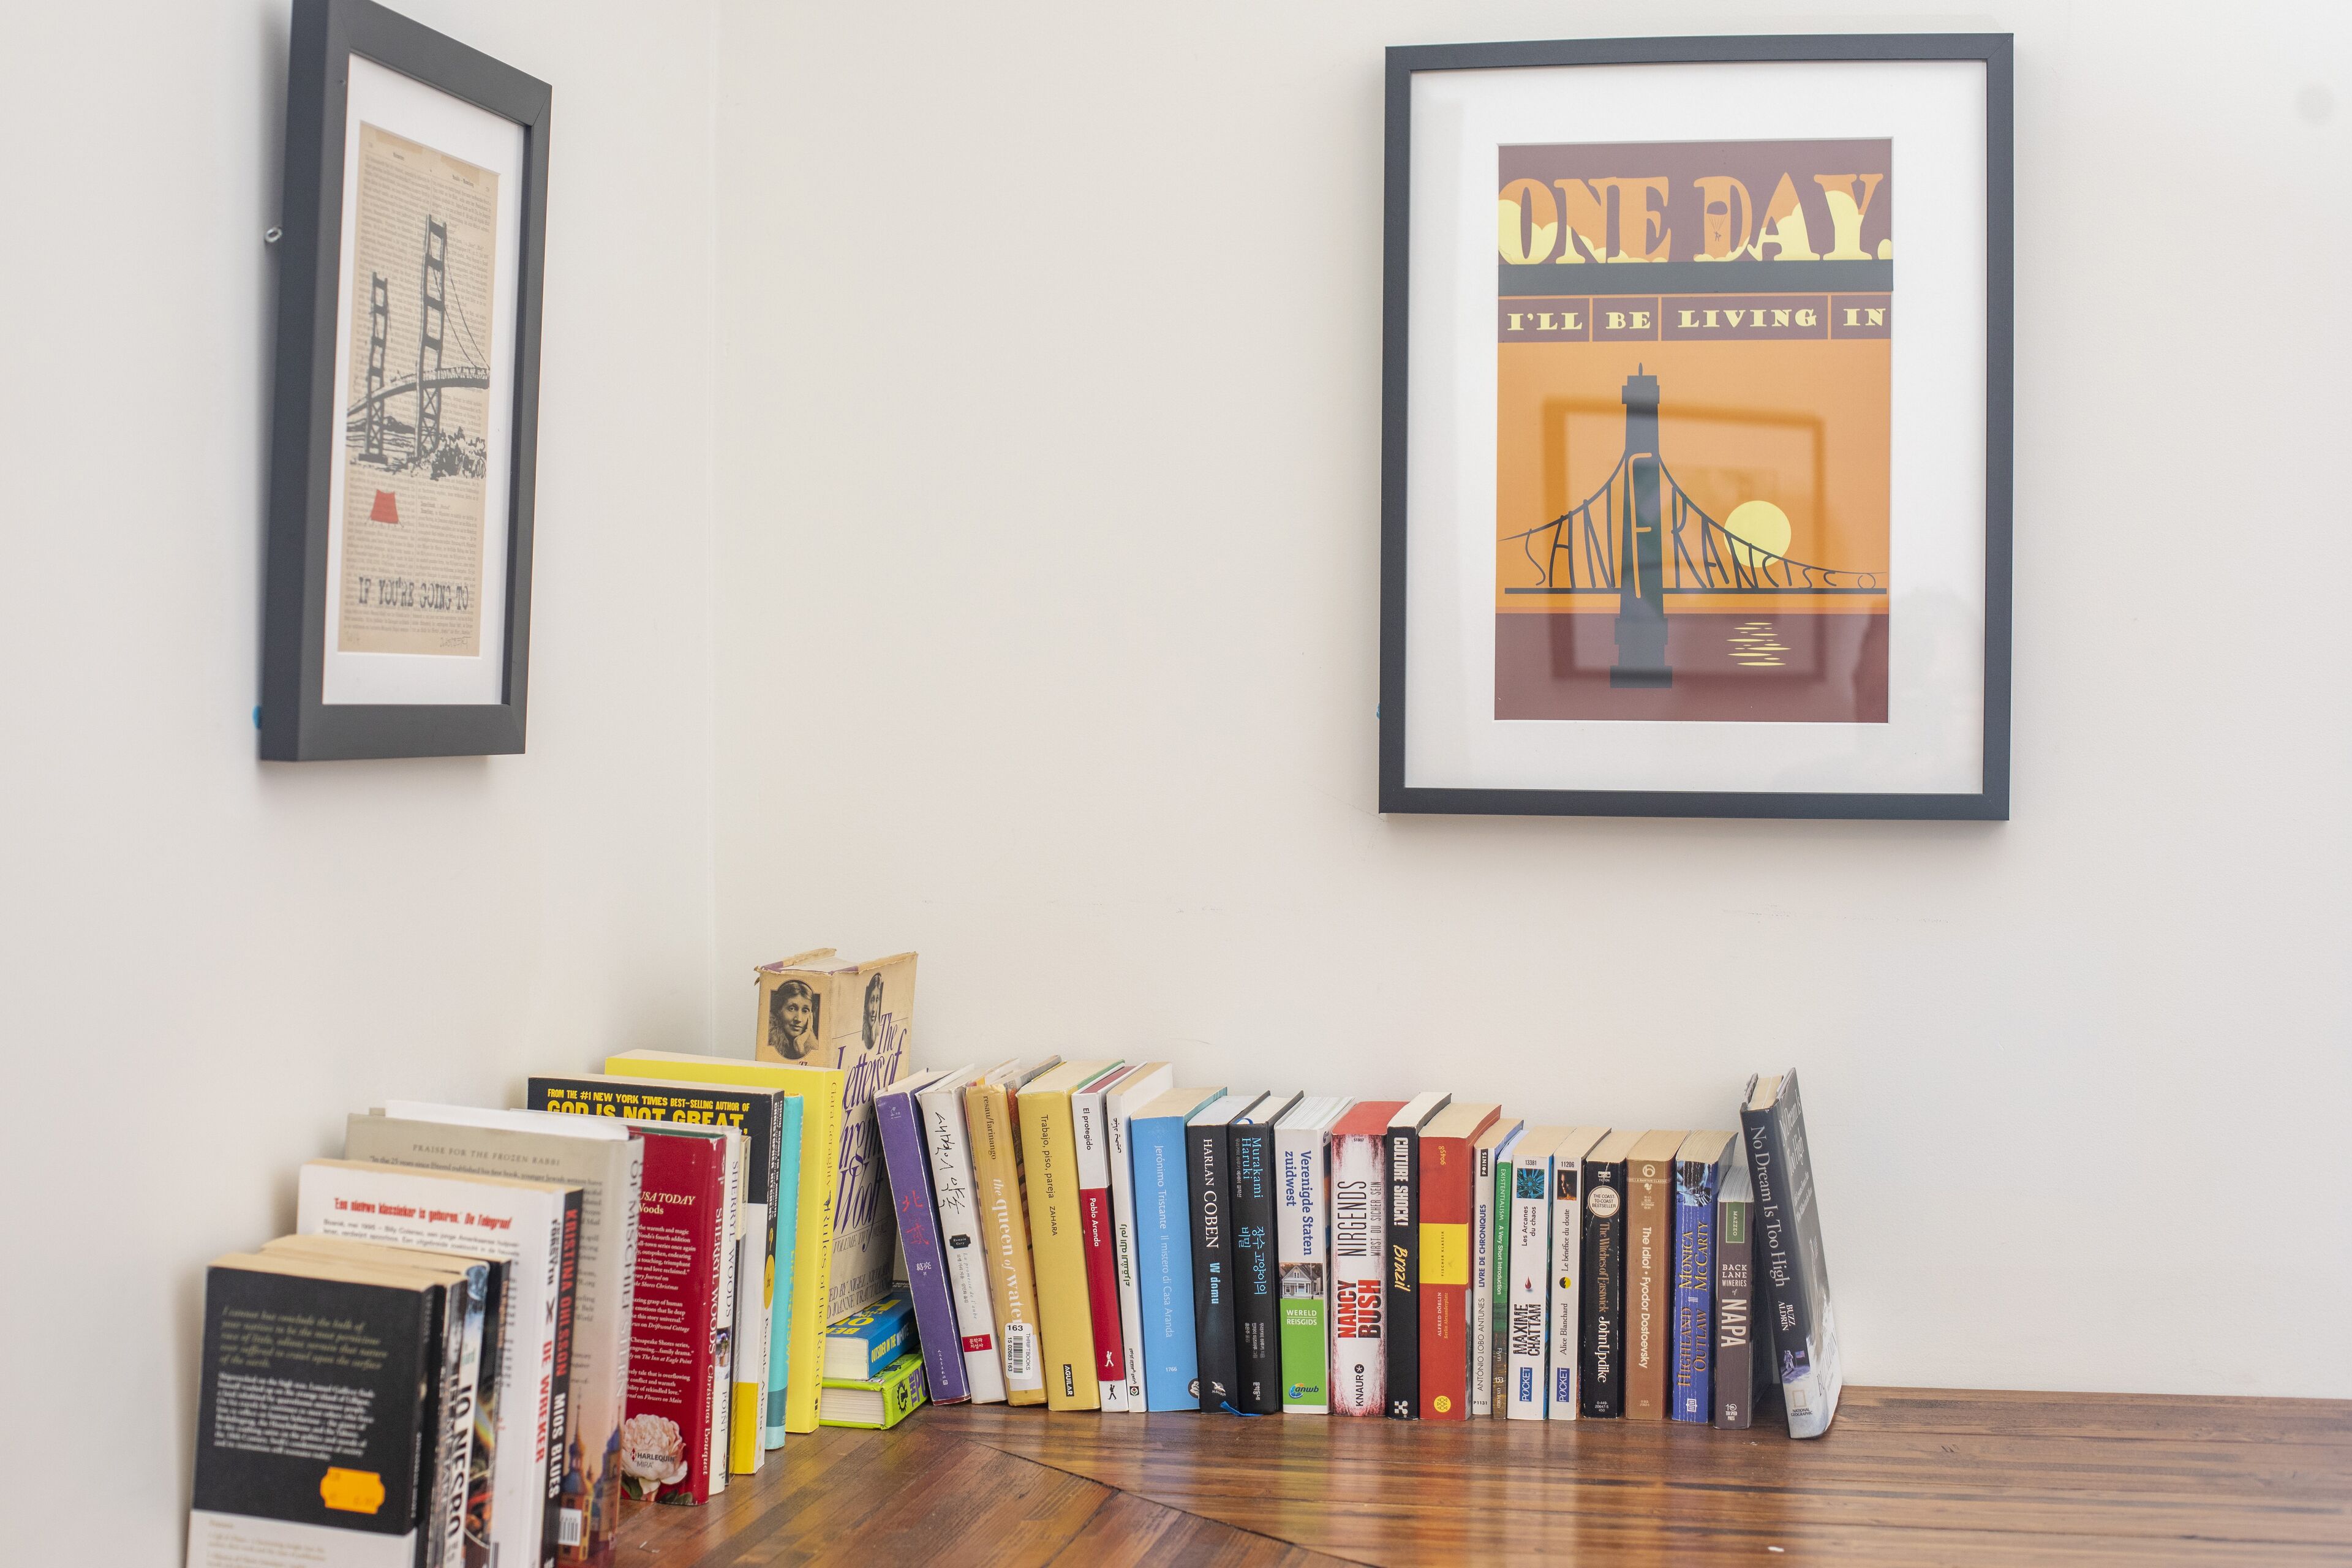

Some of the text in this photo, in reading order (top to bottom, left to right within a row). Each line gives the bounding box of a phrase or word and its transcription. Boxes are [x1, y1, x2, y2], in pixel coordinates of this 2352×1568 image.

[1498, 172, 1891, 265] ONE DAY.
[1507, 308, 1886, 331] I'LL BE LIVING IN
[1525, 453, 1876, 598] SAN FRANCISCO
[359, 577, 469, 610] IF YOU'RE GOING TO
[877, 1012, 897, 1055] The
[883, 1028, 907, 1086] of
[547, 1100, 589, 1114] GOD
[597, 1104, 616, 1117] IS
[624, 1106, 665, 1121] NOT
[548, 1088, 750, 1112] FROM THE #1 NEW YORK TIMES BEST-SELLING AUTHOR OF
[983, 1096, 997, 1159] resau/farinango
[1082, 1115, 1093, 1150] protegido
[413, 1144, 560, 1166] PRAISE FOR THE FROZEN RABBI
[1041, 1114, 1058, 1236] Trabajo, piso, pareja ZAHARA
[1155, 1145, 1164, 1188] Jerónimo
[1242, 1137, 1253, 1180] Haruki
[1252, 1137, 1264, 1198] Murakami
[658, 1193, 696, 1205] TODAY
[992, 1177, 1004, 1196] the
[1285, 1150, 1297, 1207] zuidwest
[1393, 1137, 1409, 1226] CULTURE SHOCK!
[1090, 1198, 1101, 1247] Pablo Aranda
[1158, 1189, 1167, 1229] Tristante
[1204, 1139, 1221, 1304] HARLAN COBEN W domu
[1299, 1150, 1314, 1256] Verenigde Staten
[1337, 1182, 1366, 1256] NIRGENDS
[1370, 1182, 1382, 1256] WIRST DU SICHER SEIN
[1751, 1125, 1791, 1287] No Dream Is Too High
[725, 1161, 739, 1318] SHERRYL WOODS
[821, 1208, 831, 1268] Rules
[992, 1199, 1013, 1256] queen
[1120, 1239, 1128, 1253] الله
[1238, 1226, 1251, 1248] 비밀
[916, 1261, 932, 1271] 葛亮
[963, 1253, 968, 1262] La
[964, 1264, 973, 1289] promesse
[1001, 1259, 1016, 1272] of
[1121, 1254, 1130, 1287] الشقراء
[1161, 1243, 1169, 1274] mistero
[1252, 1226, 1267, 1294] 장수 고양이의
[1393, 1244, 1411, 1292] Brazil
[1479, 1256, 1486, 1266] DE
[1597, 1223, 1610, 1313] The Witches of Eastwick
[1679, 1231, 1694, 1289] MONICA
[556, 1209, 578, 1377] KRISTINA OHLSSON
[708, 1207, 723, 1354] SHERRYL WOODS
[820, 1275, 825, 1289] of
[969, 1291, 974, 1299] de
[1163, 1275, 1172, 1284] di
[1163, 1287, 1172, 1305] Casa
[1638, 1227, 1652, 1369] The Idiot Fyodor Dostoevsky
[648, 1322, 690, 1334] Driftwood Cottage
[1165, 1308, 1175, 1338] Aranda
[1337, 1280, 1357, 1338] NANCY
[1358, 1280, 1381, 1338] BUSH
[1513, 1303, 1528, 1355] MAXIME
[1527, 1303, 1541, 1356] CHATTAM
[1721, 1299, 1747, 1347] NAPA
[1777, 1300, 1789, 1332] ALDRIN
[1786, 1303, 1796, 1326] BUZZ
[815, 1332, 824, 1387] Road
[871, 1342, 886, 1363] OUTSIDER
[886, 1338, 891, 1352] IN
[896, 1324, 910, 1345] WHITE
[1594, 1316, 1610, 1383] John Updike
[1677, 1307, 1692, 1387] HIGHLAND
[1693, 1308, 1708, 1371] OUTLAW
[1064, 1365, 1074, 1396] AGUILAR
[1355, 1374, 1365, 1406] KNAUR
[1476, 1355, 1484, 1392] ANTÓNIO
[1521, 1367, 1531, 1401] POCKET
[1559, 1368, 1567, 1402] POCKET
[549, 1393, 566, 1499] MIOS BLUES
[637, 1452, 675, 1463] HARLEQUIN
